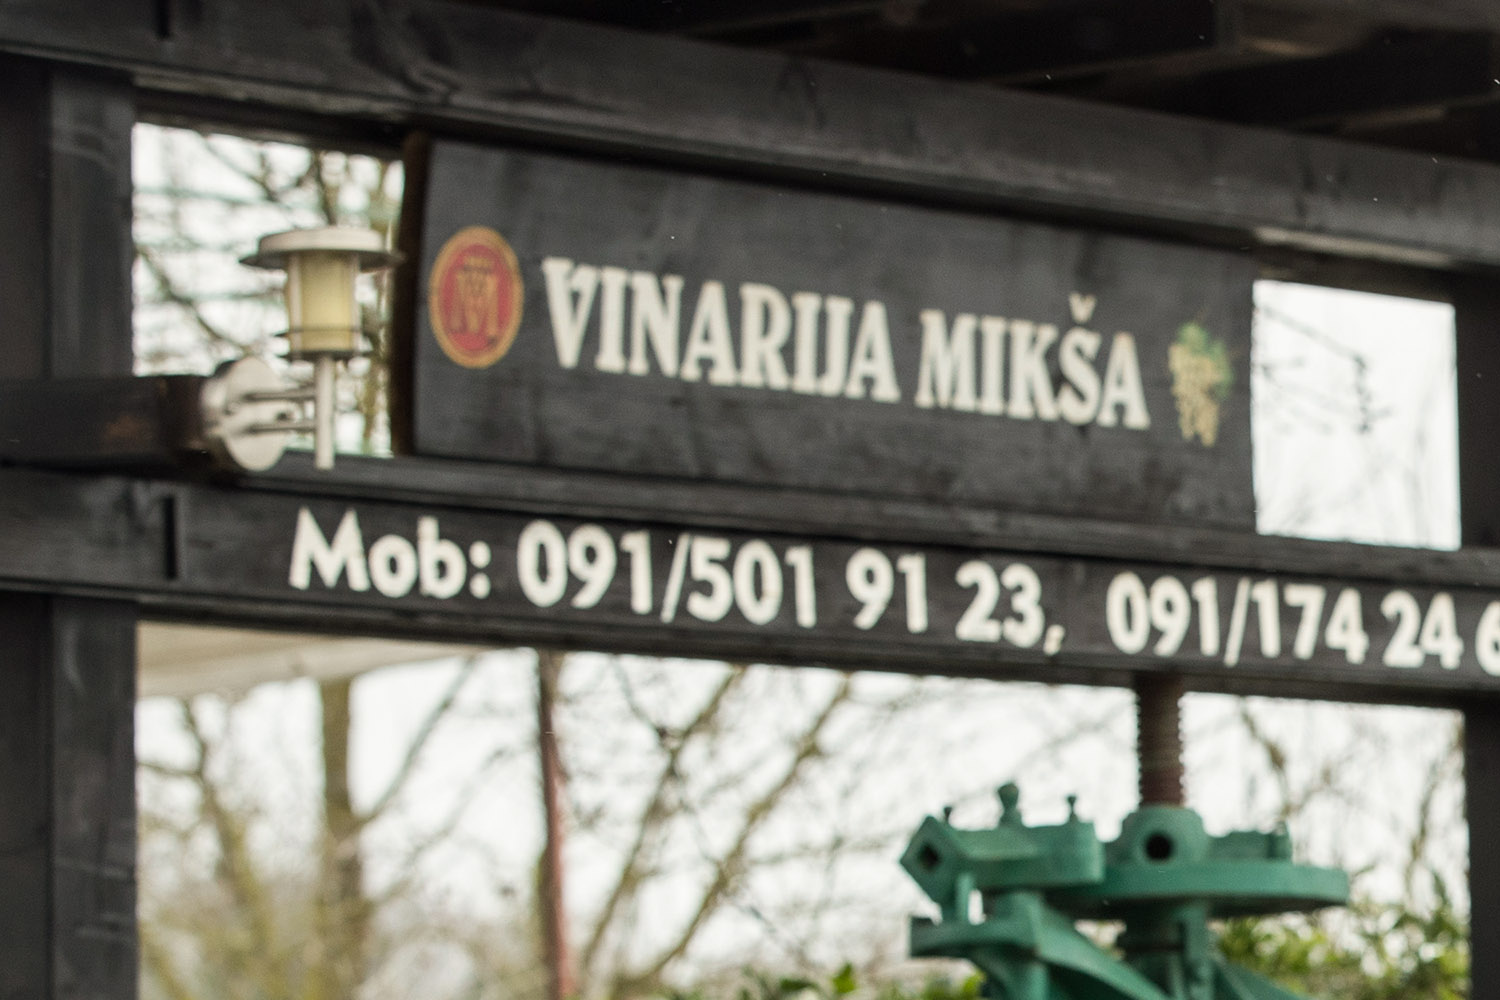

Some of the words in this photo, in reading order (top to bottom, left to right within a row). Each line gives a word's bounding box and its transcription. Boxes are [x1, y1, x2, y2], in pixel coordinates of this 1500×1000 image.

[542, 256, 901, 404] VINARIJA
[914, 293, 1151, 431] MIKŠA
[289, 506, 491, 600] Mob:
[516, 519, 817, 629] 091/501
[845, 547, 929, 633] 91
[954, 559, 1065, 656] 23,
[1105, 572, 1370, 667] 091/174
[1380, 590, 1465, 671] 24
